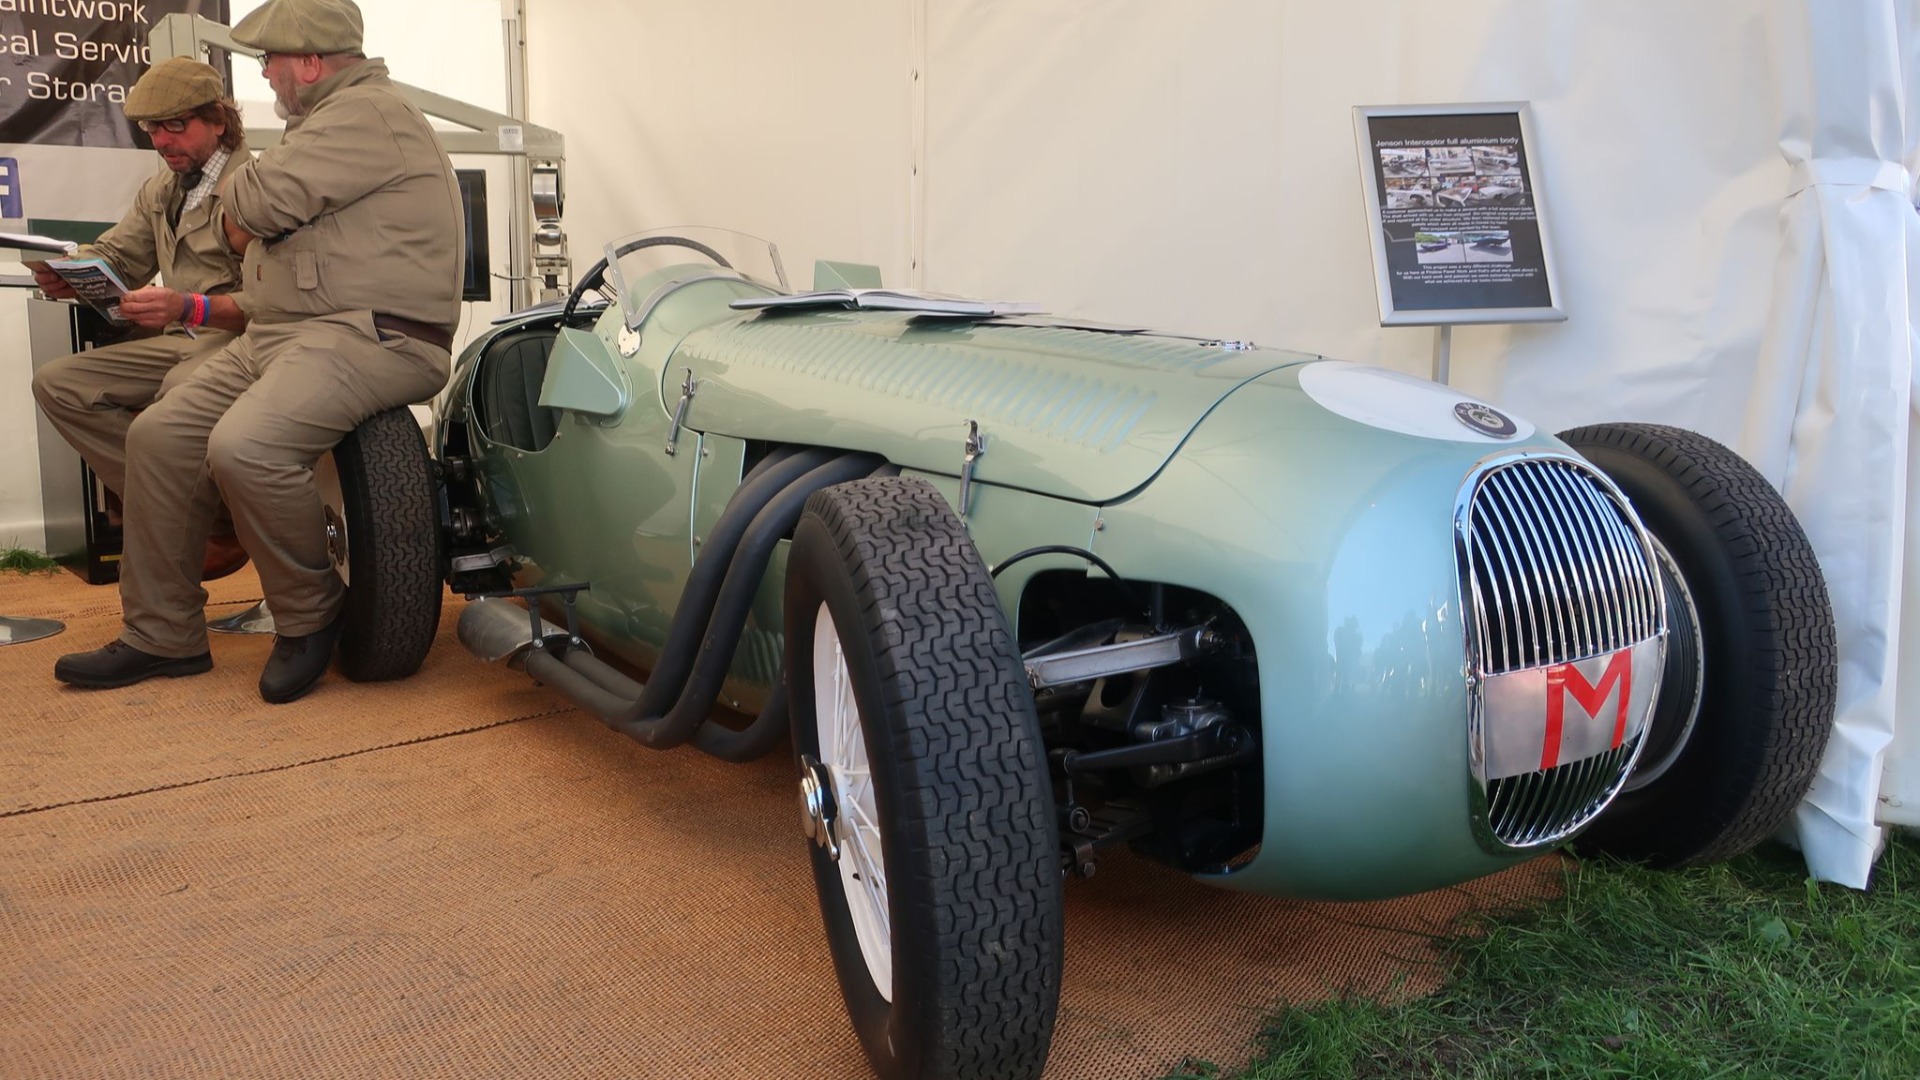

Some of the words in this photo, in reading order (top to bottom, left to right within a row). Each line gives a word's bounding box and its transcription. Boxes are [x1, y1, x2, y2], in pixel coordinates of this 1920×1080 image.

[27, 71, 134, 104] Stora
[1405, 139, 1445, 147] Interceptor
[1540, 648, 1632, 770] M
